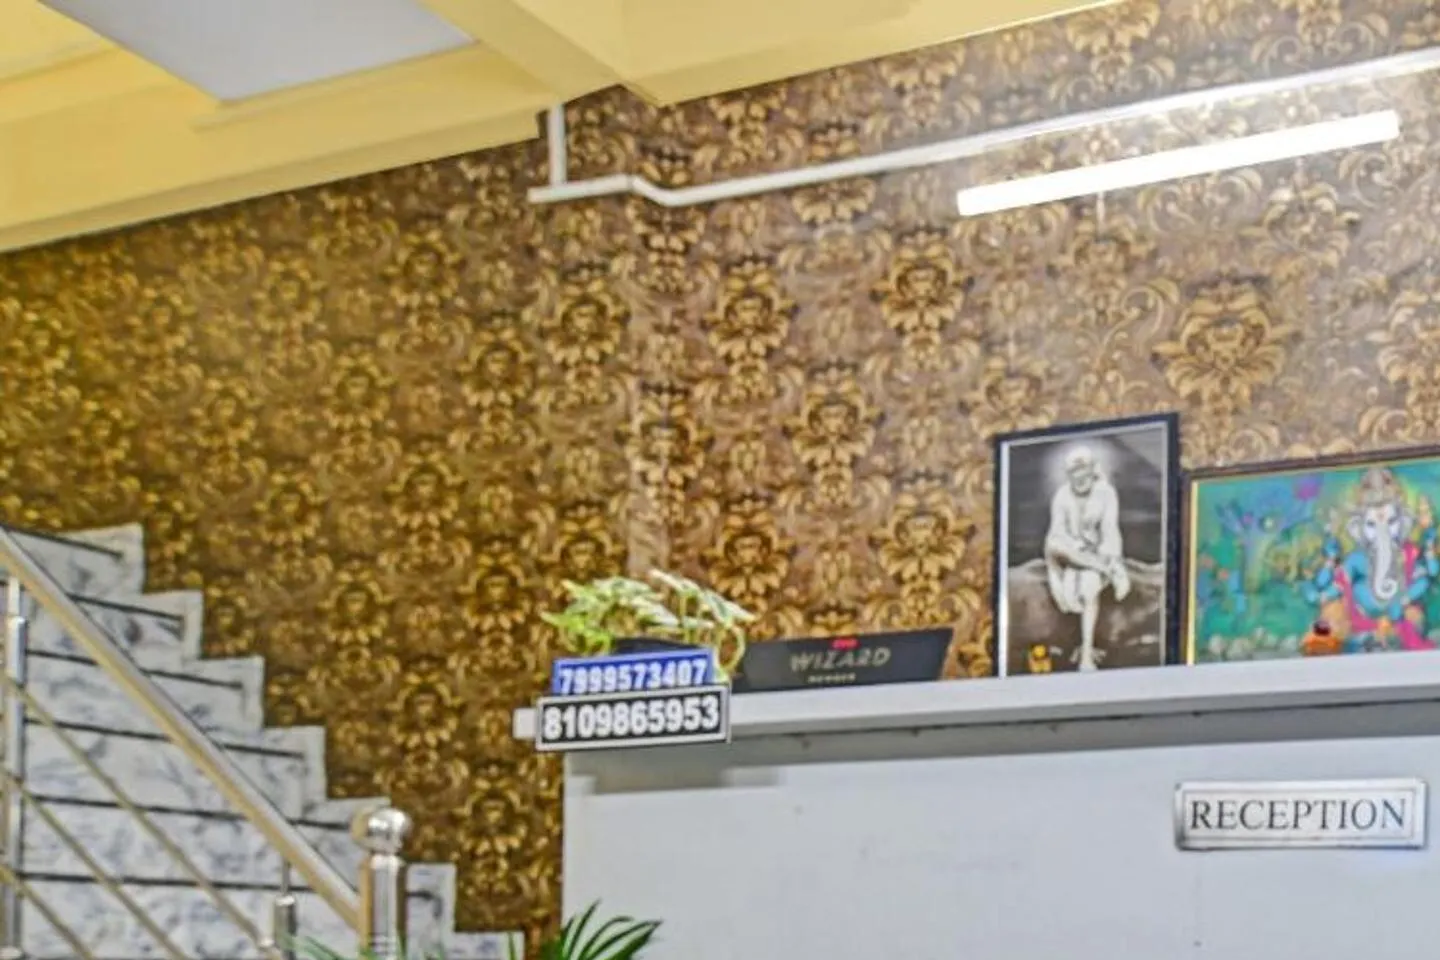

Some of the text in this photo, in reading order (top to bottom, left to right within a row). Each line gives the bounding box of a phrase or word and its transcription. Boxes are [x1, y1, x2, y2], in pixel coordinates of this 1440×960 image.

[790, 647, 891, 672] WIZARD
[560, 659, 708, 695] 7999573407
[544, 695, 719, 740] 8109865953
[1190, 799, 1406, 831] RECEPTION
